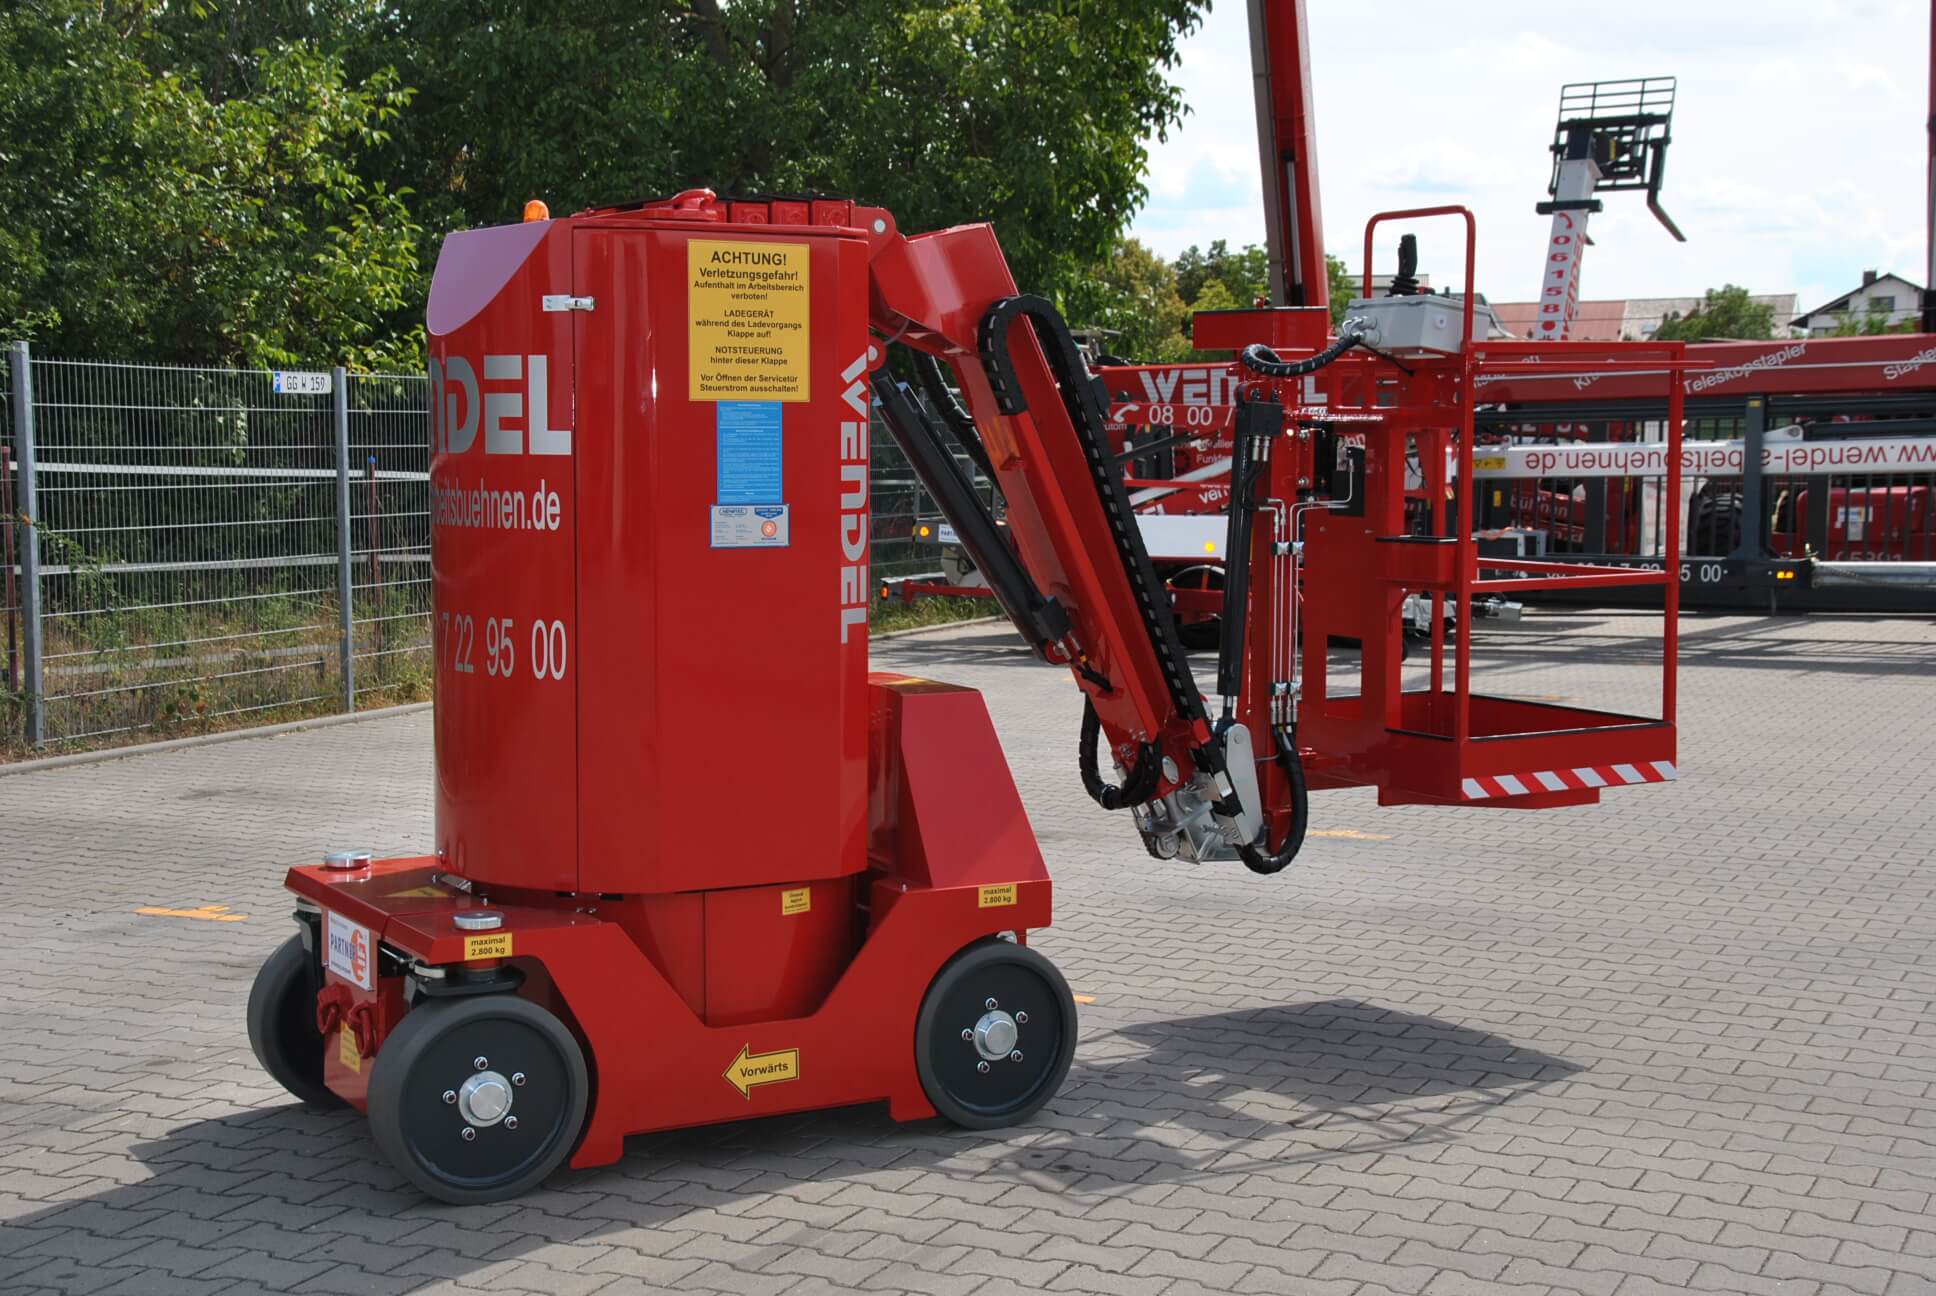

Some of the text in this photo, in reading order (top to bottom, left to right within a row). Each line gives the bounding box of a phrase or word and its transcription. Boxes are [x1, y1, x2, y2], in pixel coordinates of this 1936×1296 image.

[710, 250, 787, 266] ACHTUNG!
[699, 267, 798, 282] Verletzungsgefahr!
[694, 281, 804, 292] Aufenthalt im Arbeitsbereich
[724, 309, 774, 318] LADEGERÄT
[731, 320, 746, 328] des
[747, 320, 802, 330] Ladevorgangs
[727, 330, 771, 338] Klappe auf!
[715, 346, 783, 355] NOTSTEUERUNG
[710, 356, 733, 364] hinter
[761, 357, 788, 366] Klappe
[1683, 342, 1806, 394] Teleskopstapler
[700, 372, 798, 382] Vor Öffnen der Servicetür
[286, 376, 298, 390] GG
[310, 377, 325, 391] 159
[700, 384, 799, 393] Steuerstrom ausschalten!
[1139, 367, 1328, 406] WENL
[1149, 405, 1174, 425] 08
[1187, 406, 1213, 426] 00
[840, 352, 867, 644] WENDEL
[1700, 564, 1721, 583] 00
[454, 613, 474, 673] 22
[486, 616, 515, 678] 95
[531, 619, 567, 680] 00
[983, 886, 1012, 895] maximal
[984, 895, 1012, 904] 2.800 kg
[471, 936, 506, 946] maximal
[471, 946, 505, 956] 2.800 kg
[740, 1062, 789, 1078] Vorwärts
